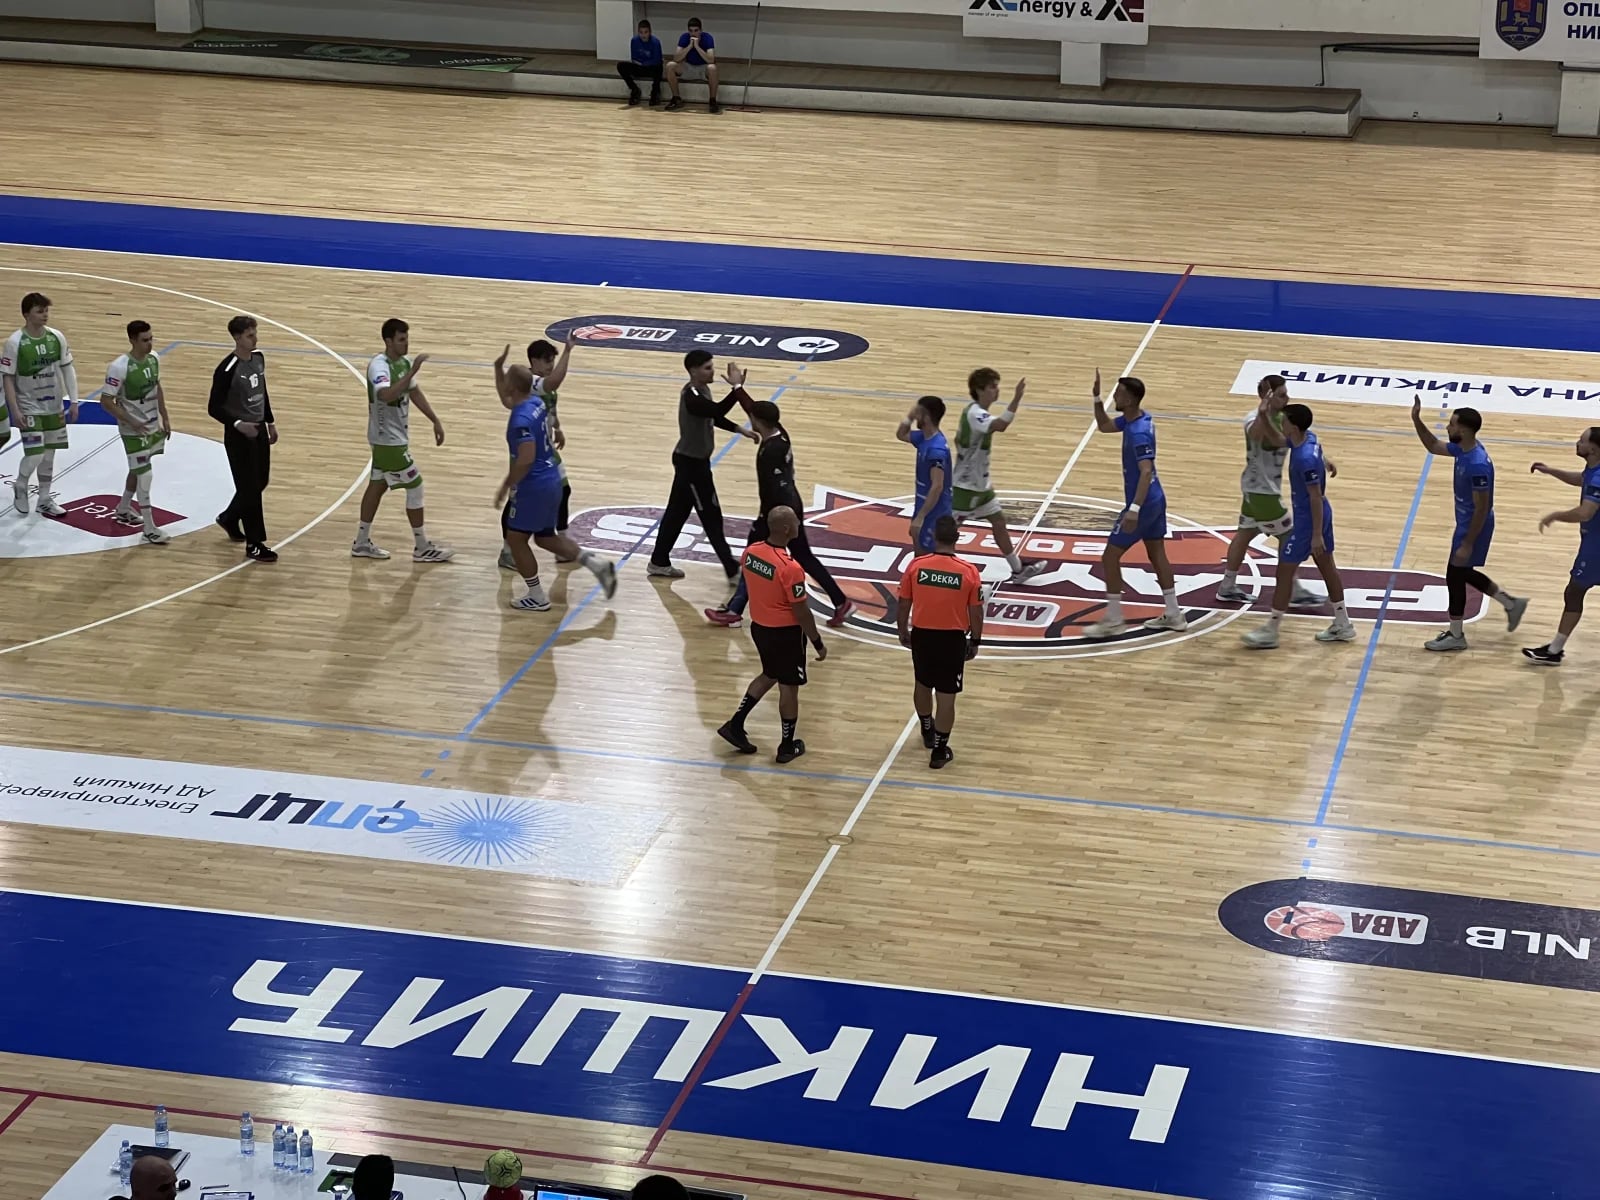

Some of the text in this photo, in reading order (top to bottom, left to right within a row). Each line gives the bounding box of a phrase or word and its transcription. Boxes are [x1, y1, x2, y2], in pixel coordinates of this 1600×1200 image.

[1080, 1, 1093, 17] &
[1567, 25, 1600, 40] НИ
[626, 328, 672, 340] ABA
[693, 333, 771, 347] NLB
[35, 344, 47, 355] 18
[248, 373, 259, 389] 16
[1280, 370, 1493, 394] НИКШИЋ
[752, 560, 772, 577] DEKRA
[930, 573, 960, 586] DEKRA
[986, 602, 1048, 622] ABA
[73, 775, 216, 800] АД Никшић
[1350, 911, 1421, 939] ABA
[1465, 926, 1591, 961] NLB
[228, 958, 1191, 1145] НИКШИЋ
